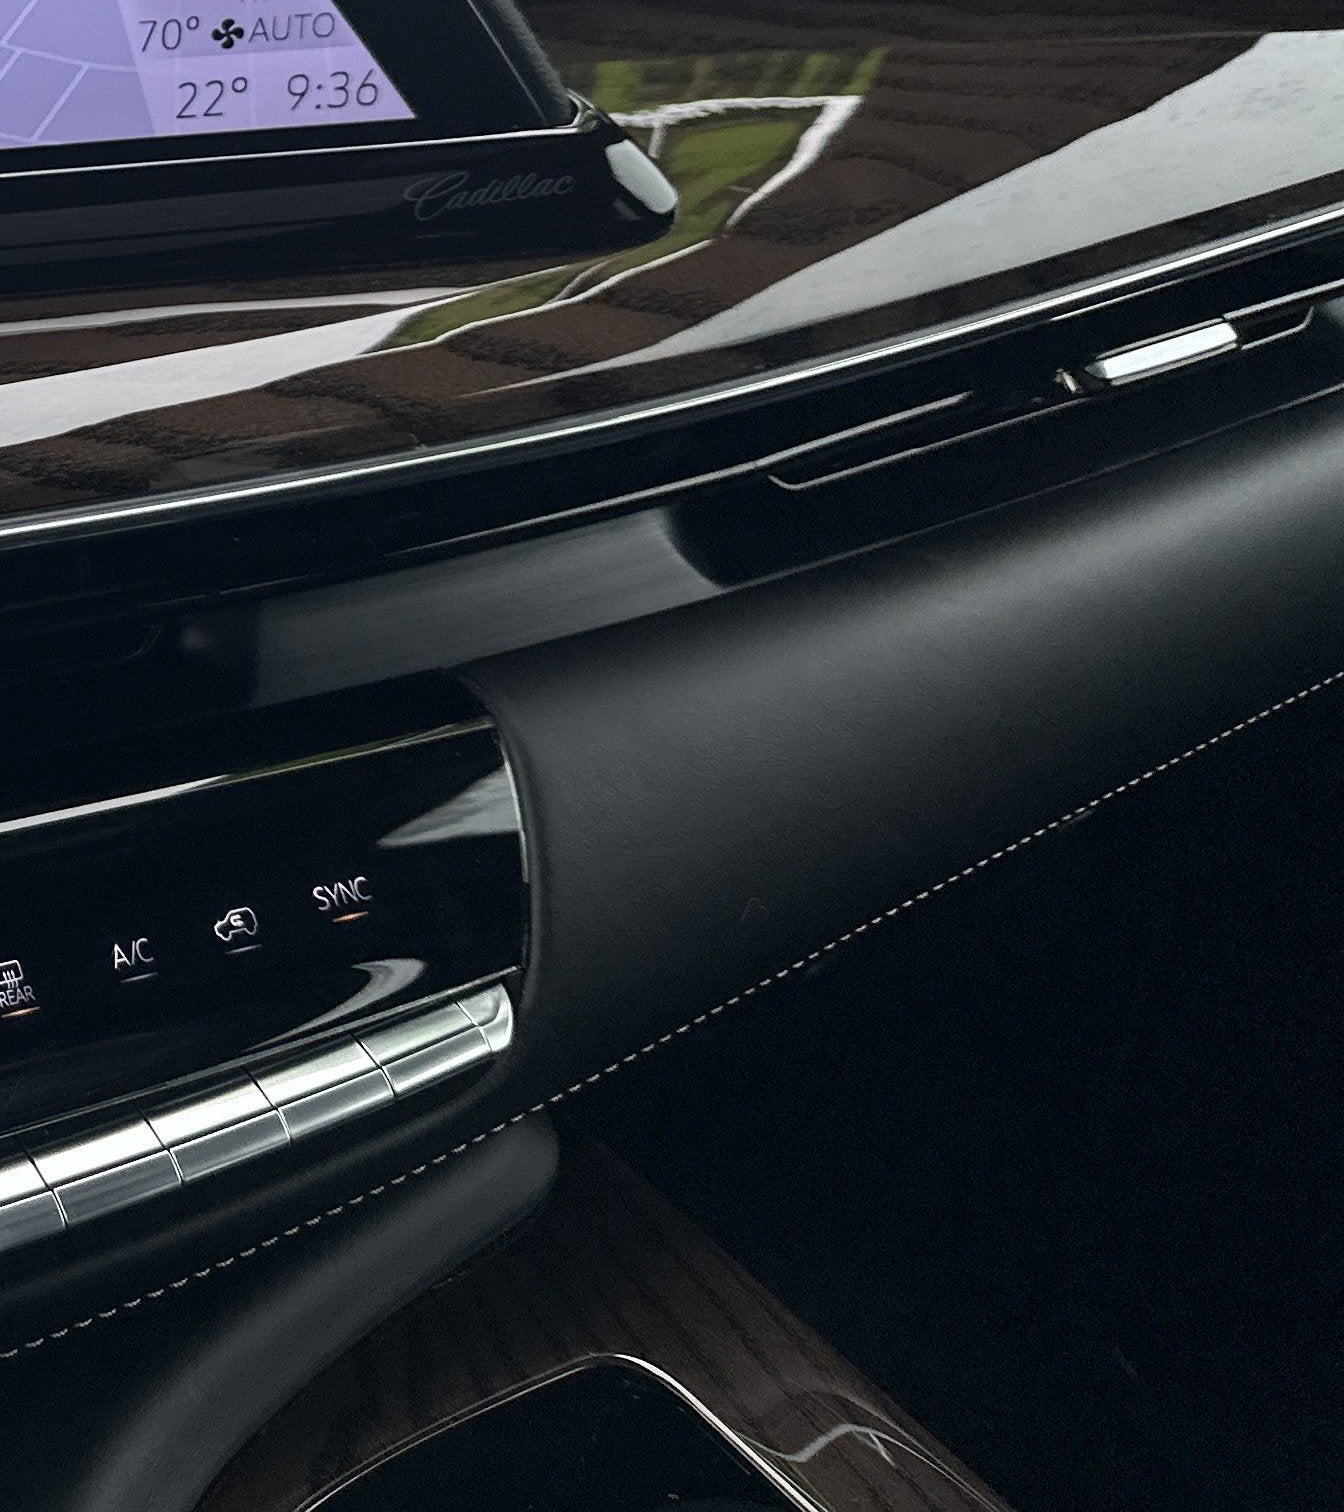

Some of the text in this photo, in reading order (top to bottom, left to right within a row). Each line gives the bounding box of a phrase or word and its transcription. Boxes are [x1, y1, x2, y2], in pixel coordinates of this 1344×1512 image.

[139, 13, 336, 53] 70° AUTO
[175, 68, 380, 120] 22° 9:36
[404, 171, 574, 221] Cadillac
[313, 876, 373, 912] SYNC
[113, 937, 155, 970] A/C
